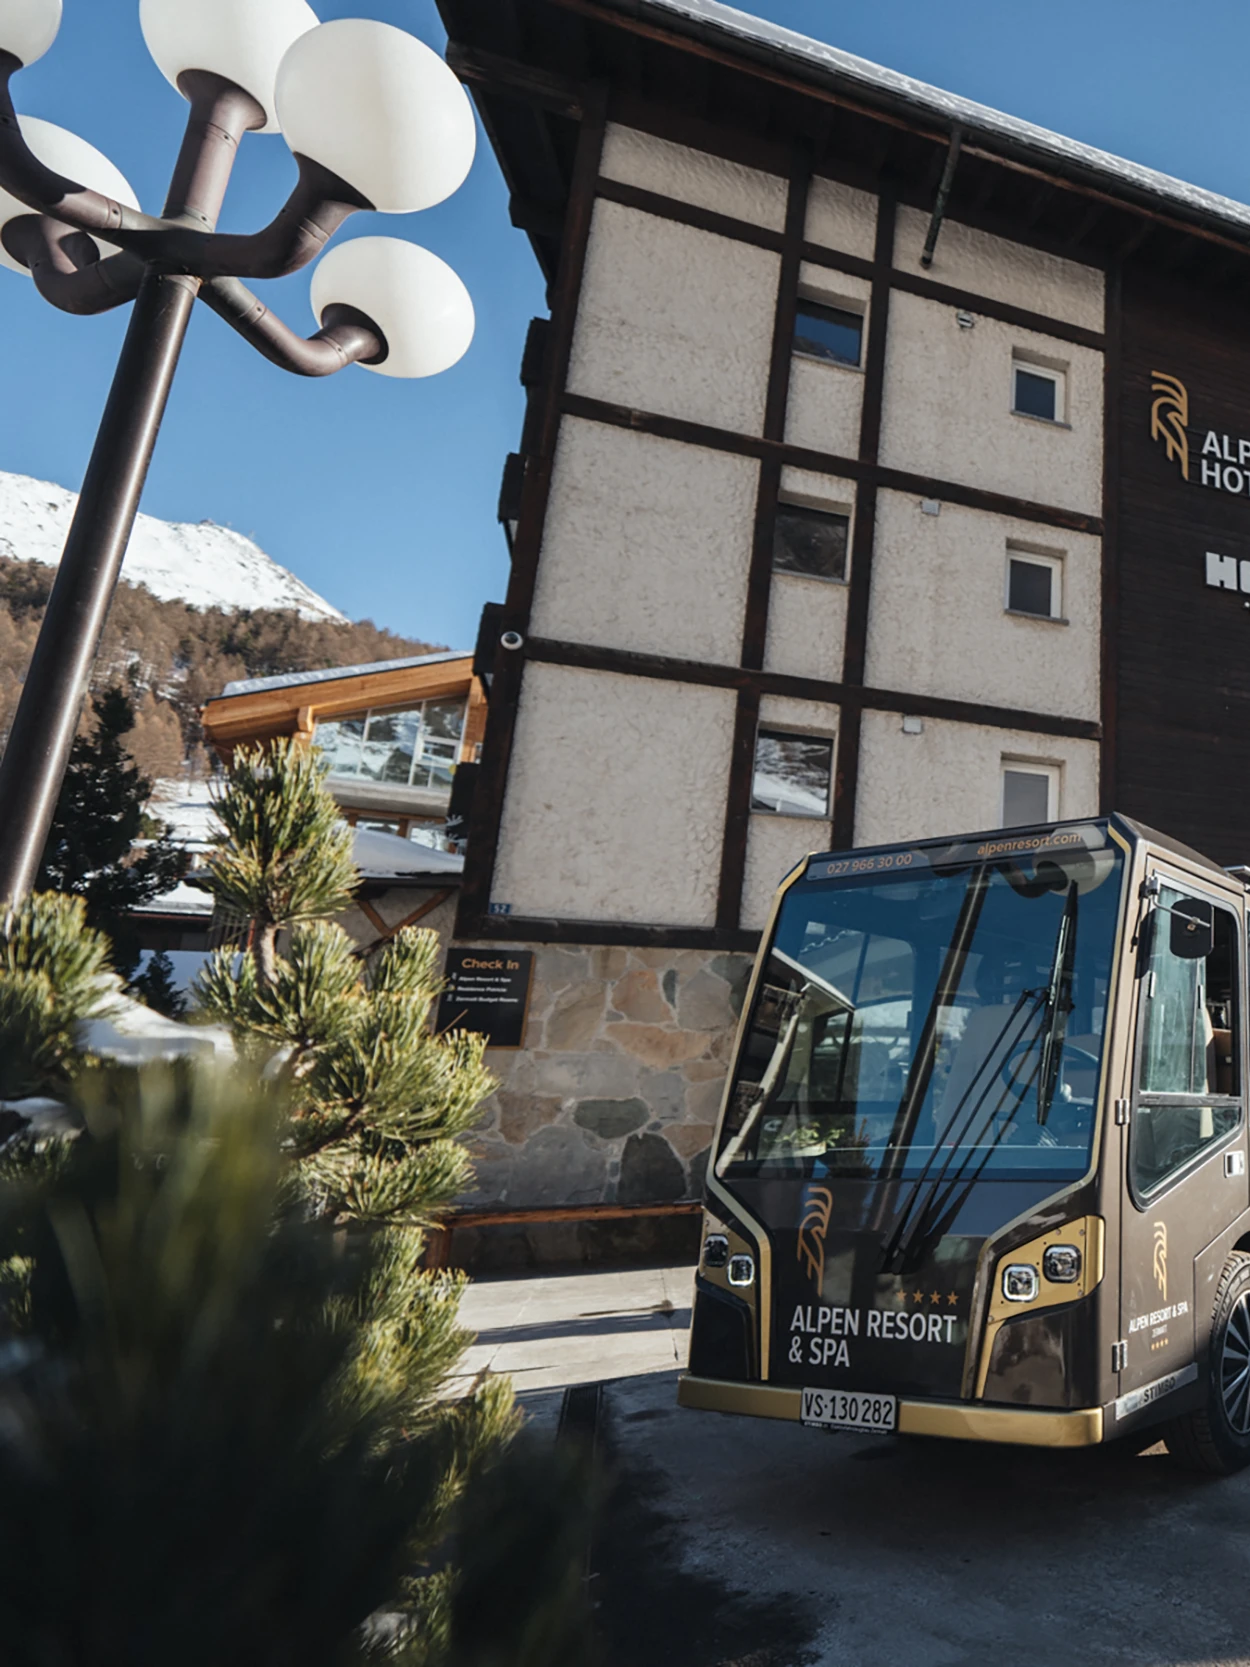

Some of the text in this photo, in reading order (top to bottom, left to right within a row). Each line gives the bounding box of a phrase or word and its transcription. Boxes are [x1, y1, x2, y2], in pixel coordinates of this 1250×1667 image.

[977, 833, 1082, 856] alpenresort.com
[827, 853, 913, 875] 027 966 30 00
[494, 903, 506, 914] 52
[461, 958, 520, 970] Check In
[790, 1305, 957, 1343] ALPEN RESORT
[1128, 1313, 1150, 1334] ALPEN
[1149, 1305, 1172, 1326] RESORT
[1177, 1301, 1188, 1316] SPA
[788, 1335, 850, 1367] & SPA
[1143, 1375, 1177, 1403] STIMBO
